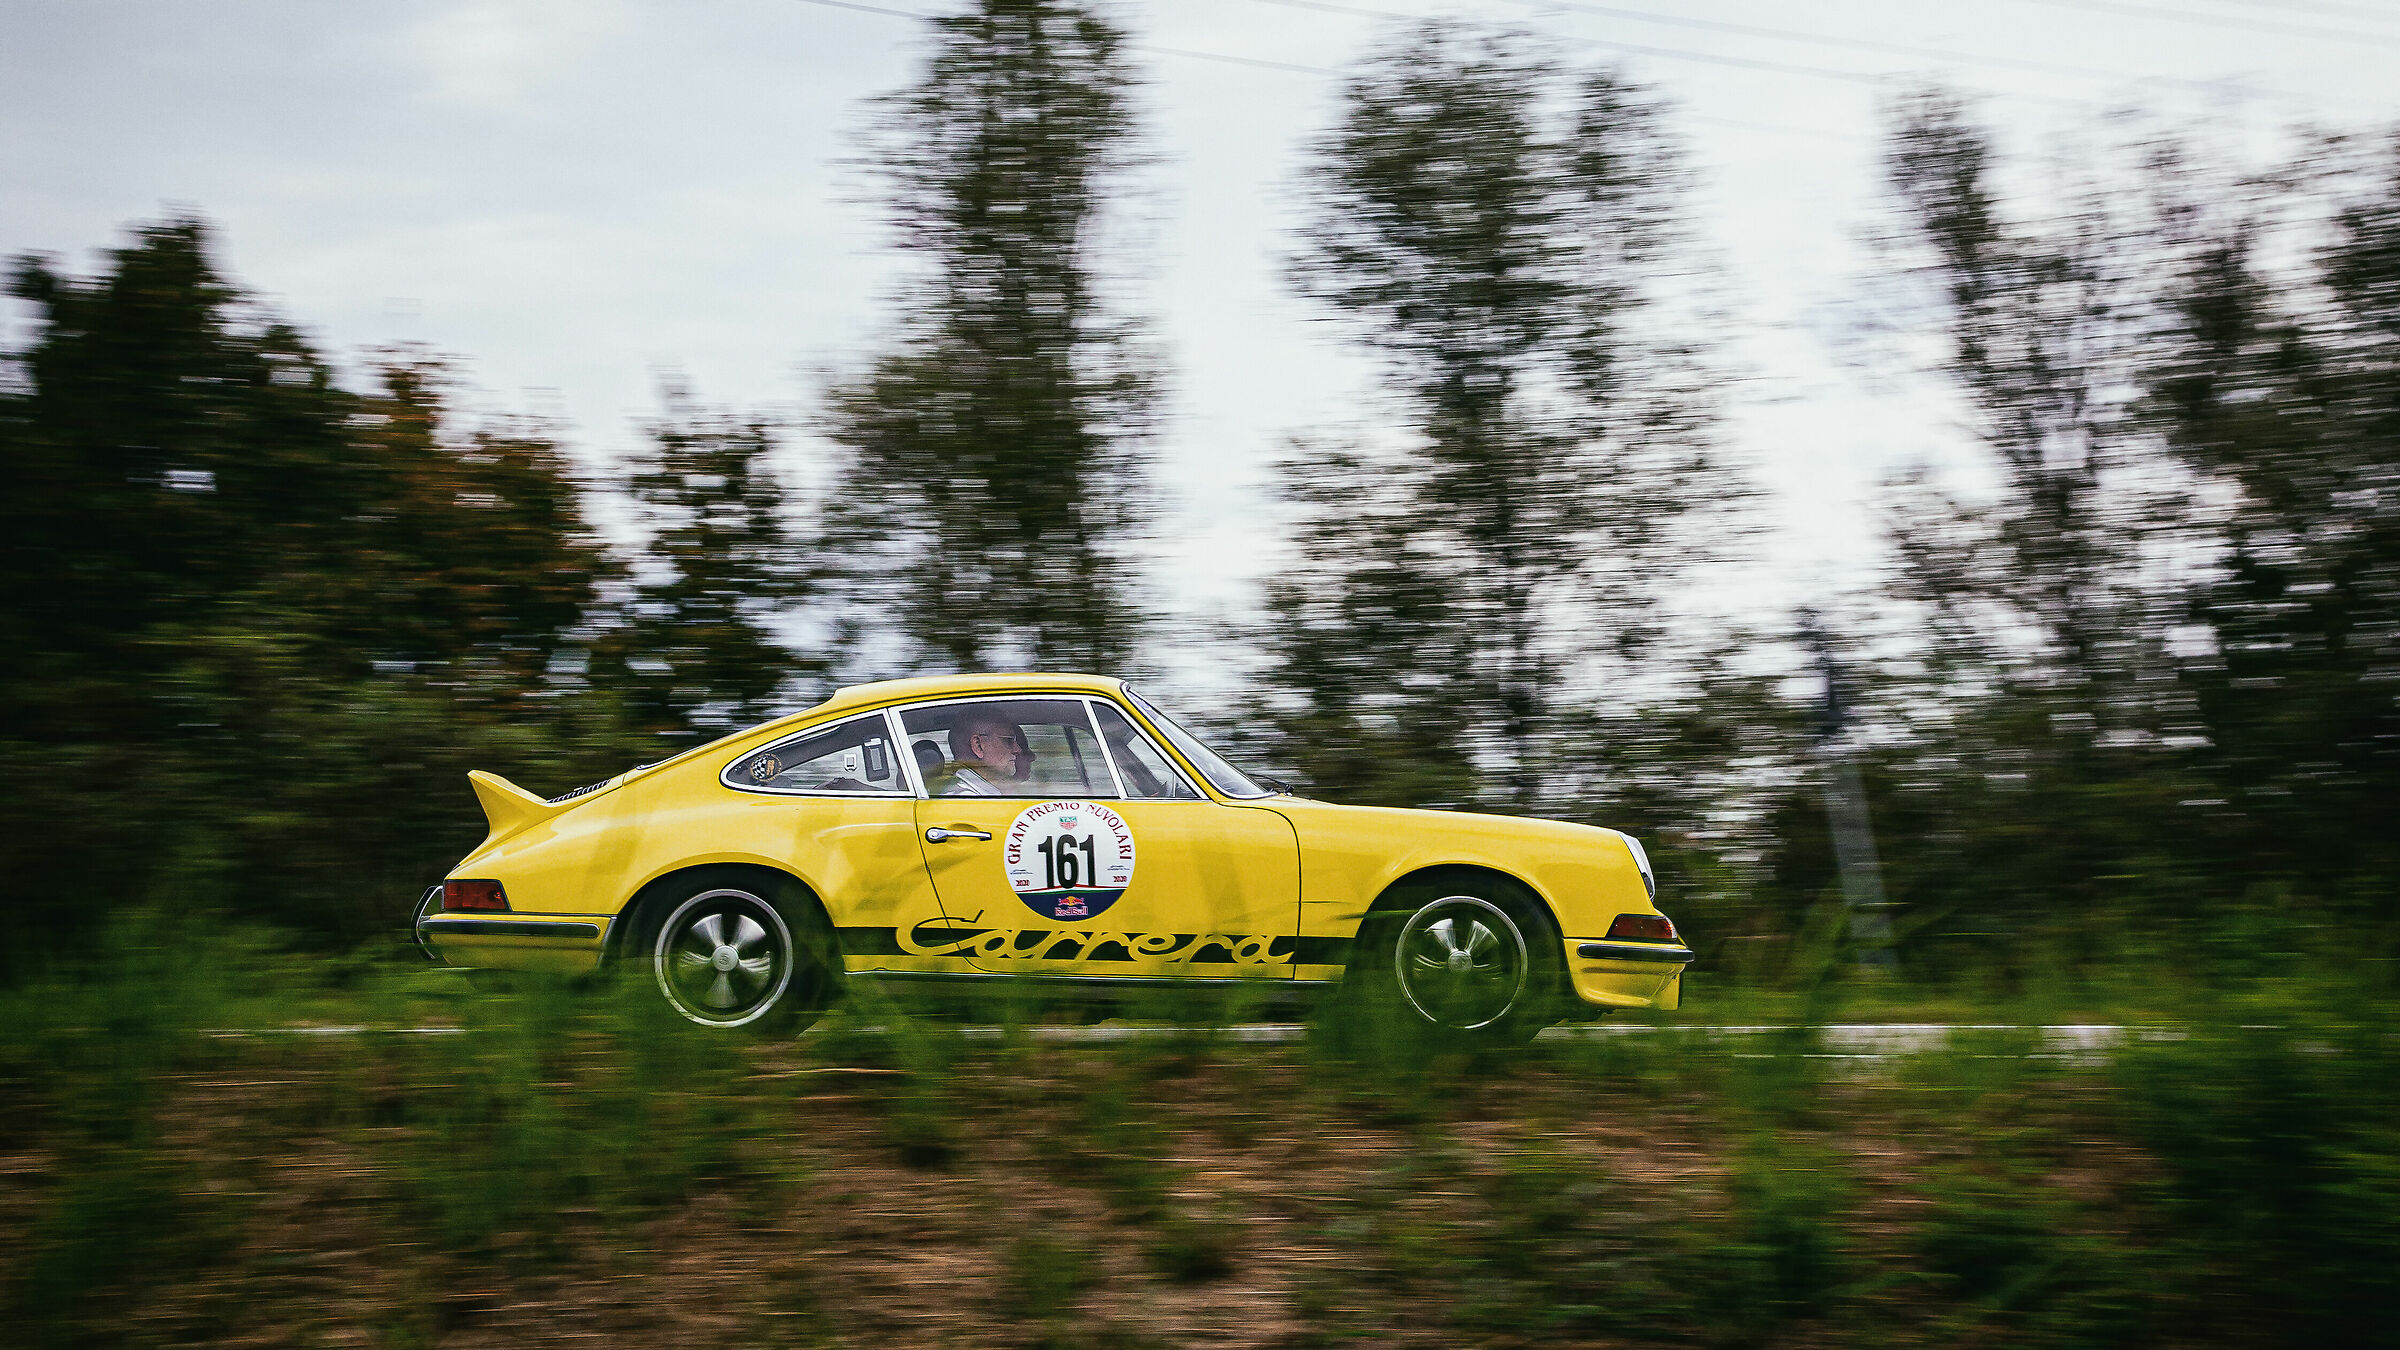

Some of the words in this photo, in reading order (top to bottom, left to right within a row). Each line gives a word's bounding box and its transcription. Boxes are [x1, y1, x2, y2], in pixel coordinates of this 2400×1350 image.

[1008, 821, 1030, 864] GRAN
[1026, 802, 1080, 821] PREMIO
[1085, 804, 1132, 860] NUVOLARI
[1038, 834, 1096, 889] 161
[896, 909, 1297, 964] Carrera
